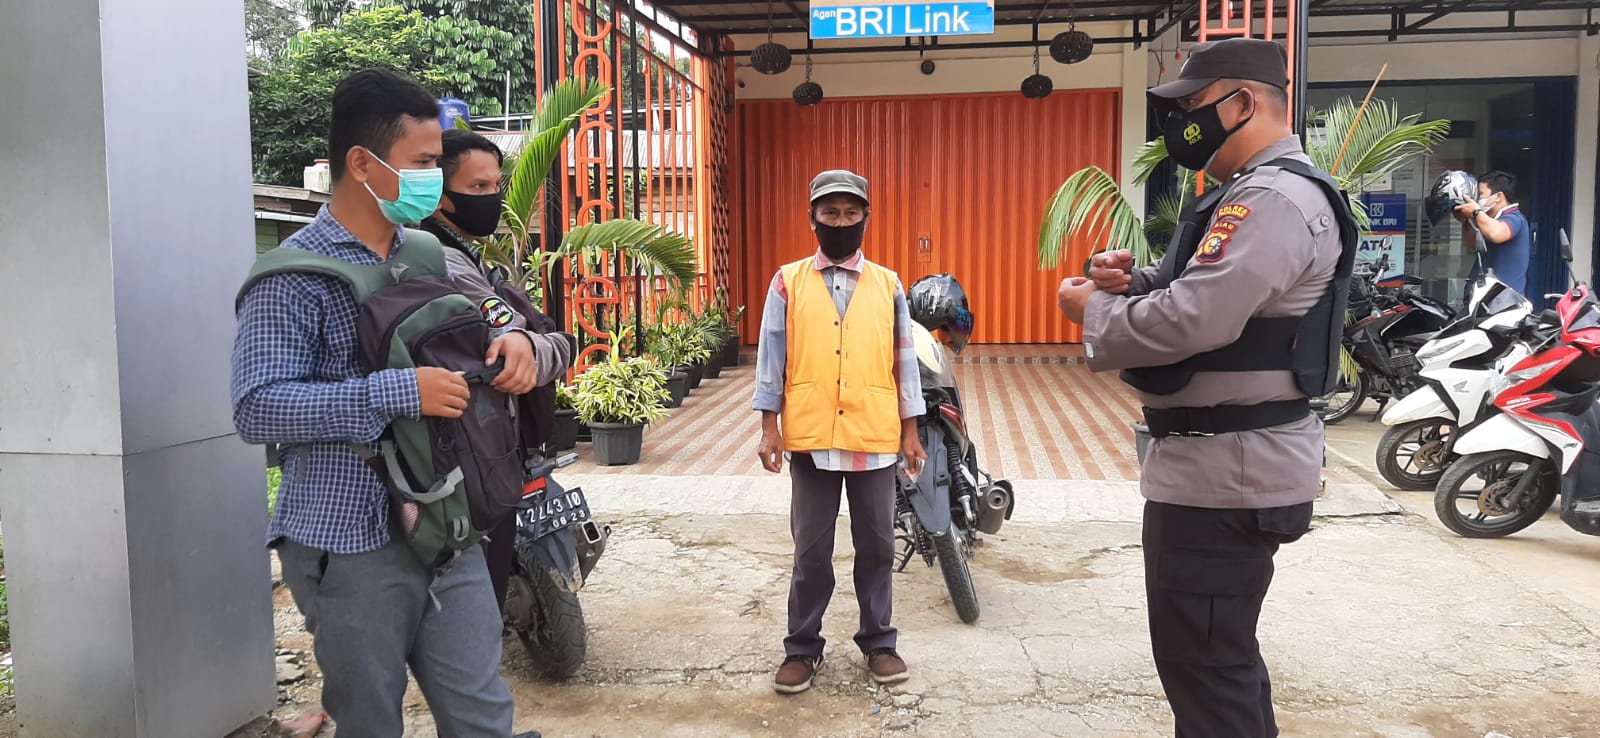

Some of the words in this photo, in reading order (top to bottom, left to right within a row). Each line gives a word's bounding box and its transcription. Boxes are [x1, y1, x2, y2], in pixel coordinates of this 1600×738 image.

[836, 6, 893, 36] BRI
[905, 5, 970, 34] Link
[1383, 218, 1397, 226] BRI
[552, 517, 567, 528] 08
[571, 509, 586, 521] 23
